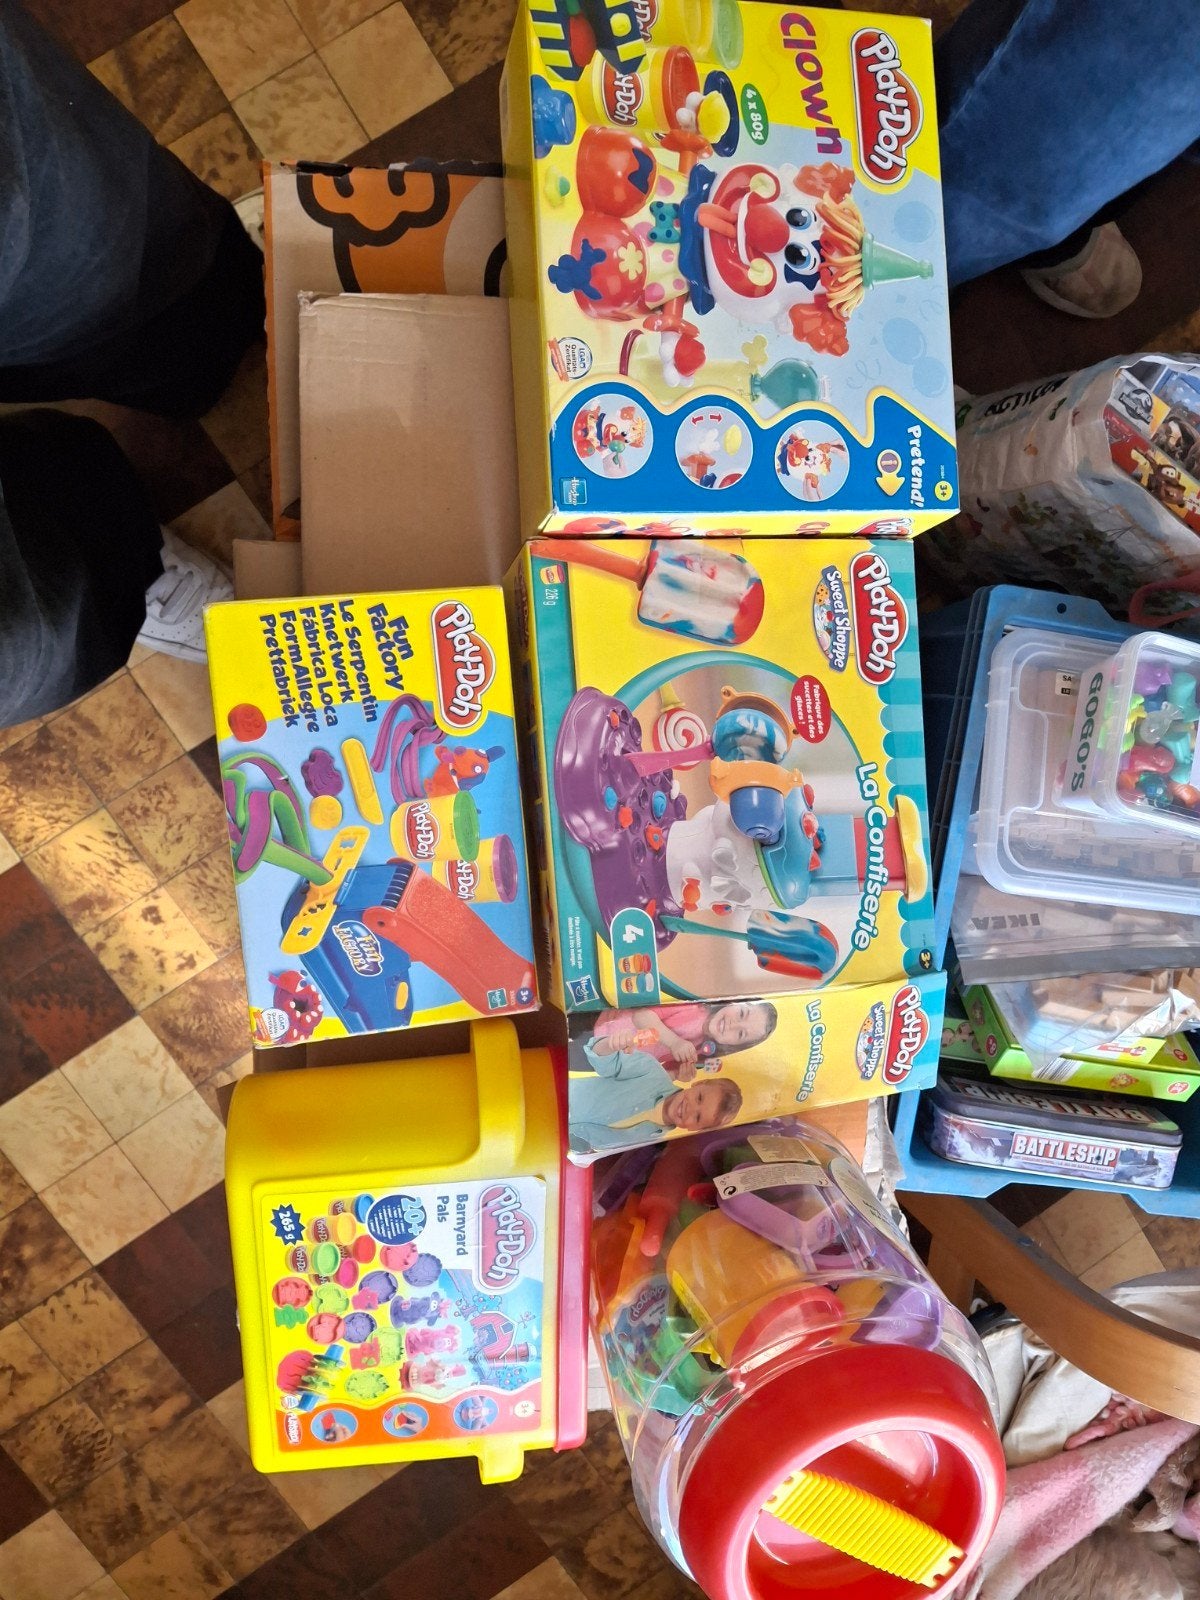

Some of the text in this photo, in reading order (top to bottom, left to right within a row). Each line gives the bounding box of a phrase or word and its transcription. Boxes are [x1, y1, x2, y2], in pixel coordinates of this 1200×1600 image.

[780, 12, 844, 154] Clown
[860, 33, 912, 170] Play-Doh
[745, 88, 765, 140] 4 x 80g
[907, 424, 926, 508] Pretend!
[939, 484, 948, 498] 3+
[545, 588, 558, 599] 226
[826, 570, 852, 668] Sweet Shoppe
[857, 556, 899, 673] Play-Doh
[319, 603, 355, 703] Knetwerk
[339, 599, 379, 723] Le Serpentin
[367, 603, 406, 690] Factory
[388, 616, 415, 659] Fun
[439, 603, 486, 717] Play-Doh
[260, 614, 300, 728] Pretfabriek
[299, 606, 339, 727] Fábrica Loca
[794, 695, 804, 720] glaces
[803, 680, 816, 738] sucettes et des
[813, 684, 825, 734] Fabrique des
[410, 802, 435, 858] Play-Doh
[853, 762, 889, 949] La Confiserie
[333, 926, 373, 972] FACTORY
[355, 934, 382, 963] Fun
[622, 924, 644, 944] 4
[971, 912, 1041, 930] IKEA
[920, 952, 931, 968] 3+
[520, 990, 529, 1002] 3+
[796, 999, 827, 1102] La Confiserie
[865, 1004, 886, 1077] Sweet Shoppe
[888, 987, 922, 1076] Play-Doh
[1014, 1135, 1117, 1166] BATTLESHIP
[278, 1210, 295, 1232] 265
[400, 1196, 425, 1236] 20+
[437, 1195, 449, 1223] Pals
[453, 1193, 469, 1256] Barnyard
[485, 1186, 527, 1280] Play-Doh
[288, 1413, 299, 1444] PLAYSKOOL
[521, 1403, 529, 1414] 3+
